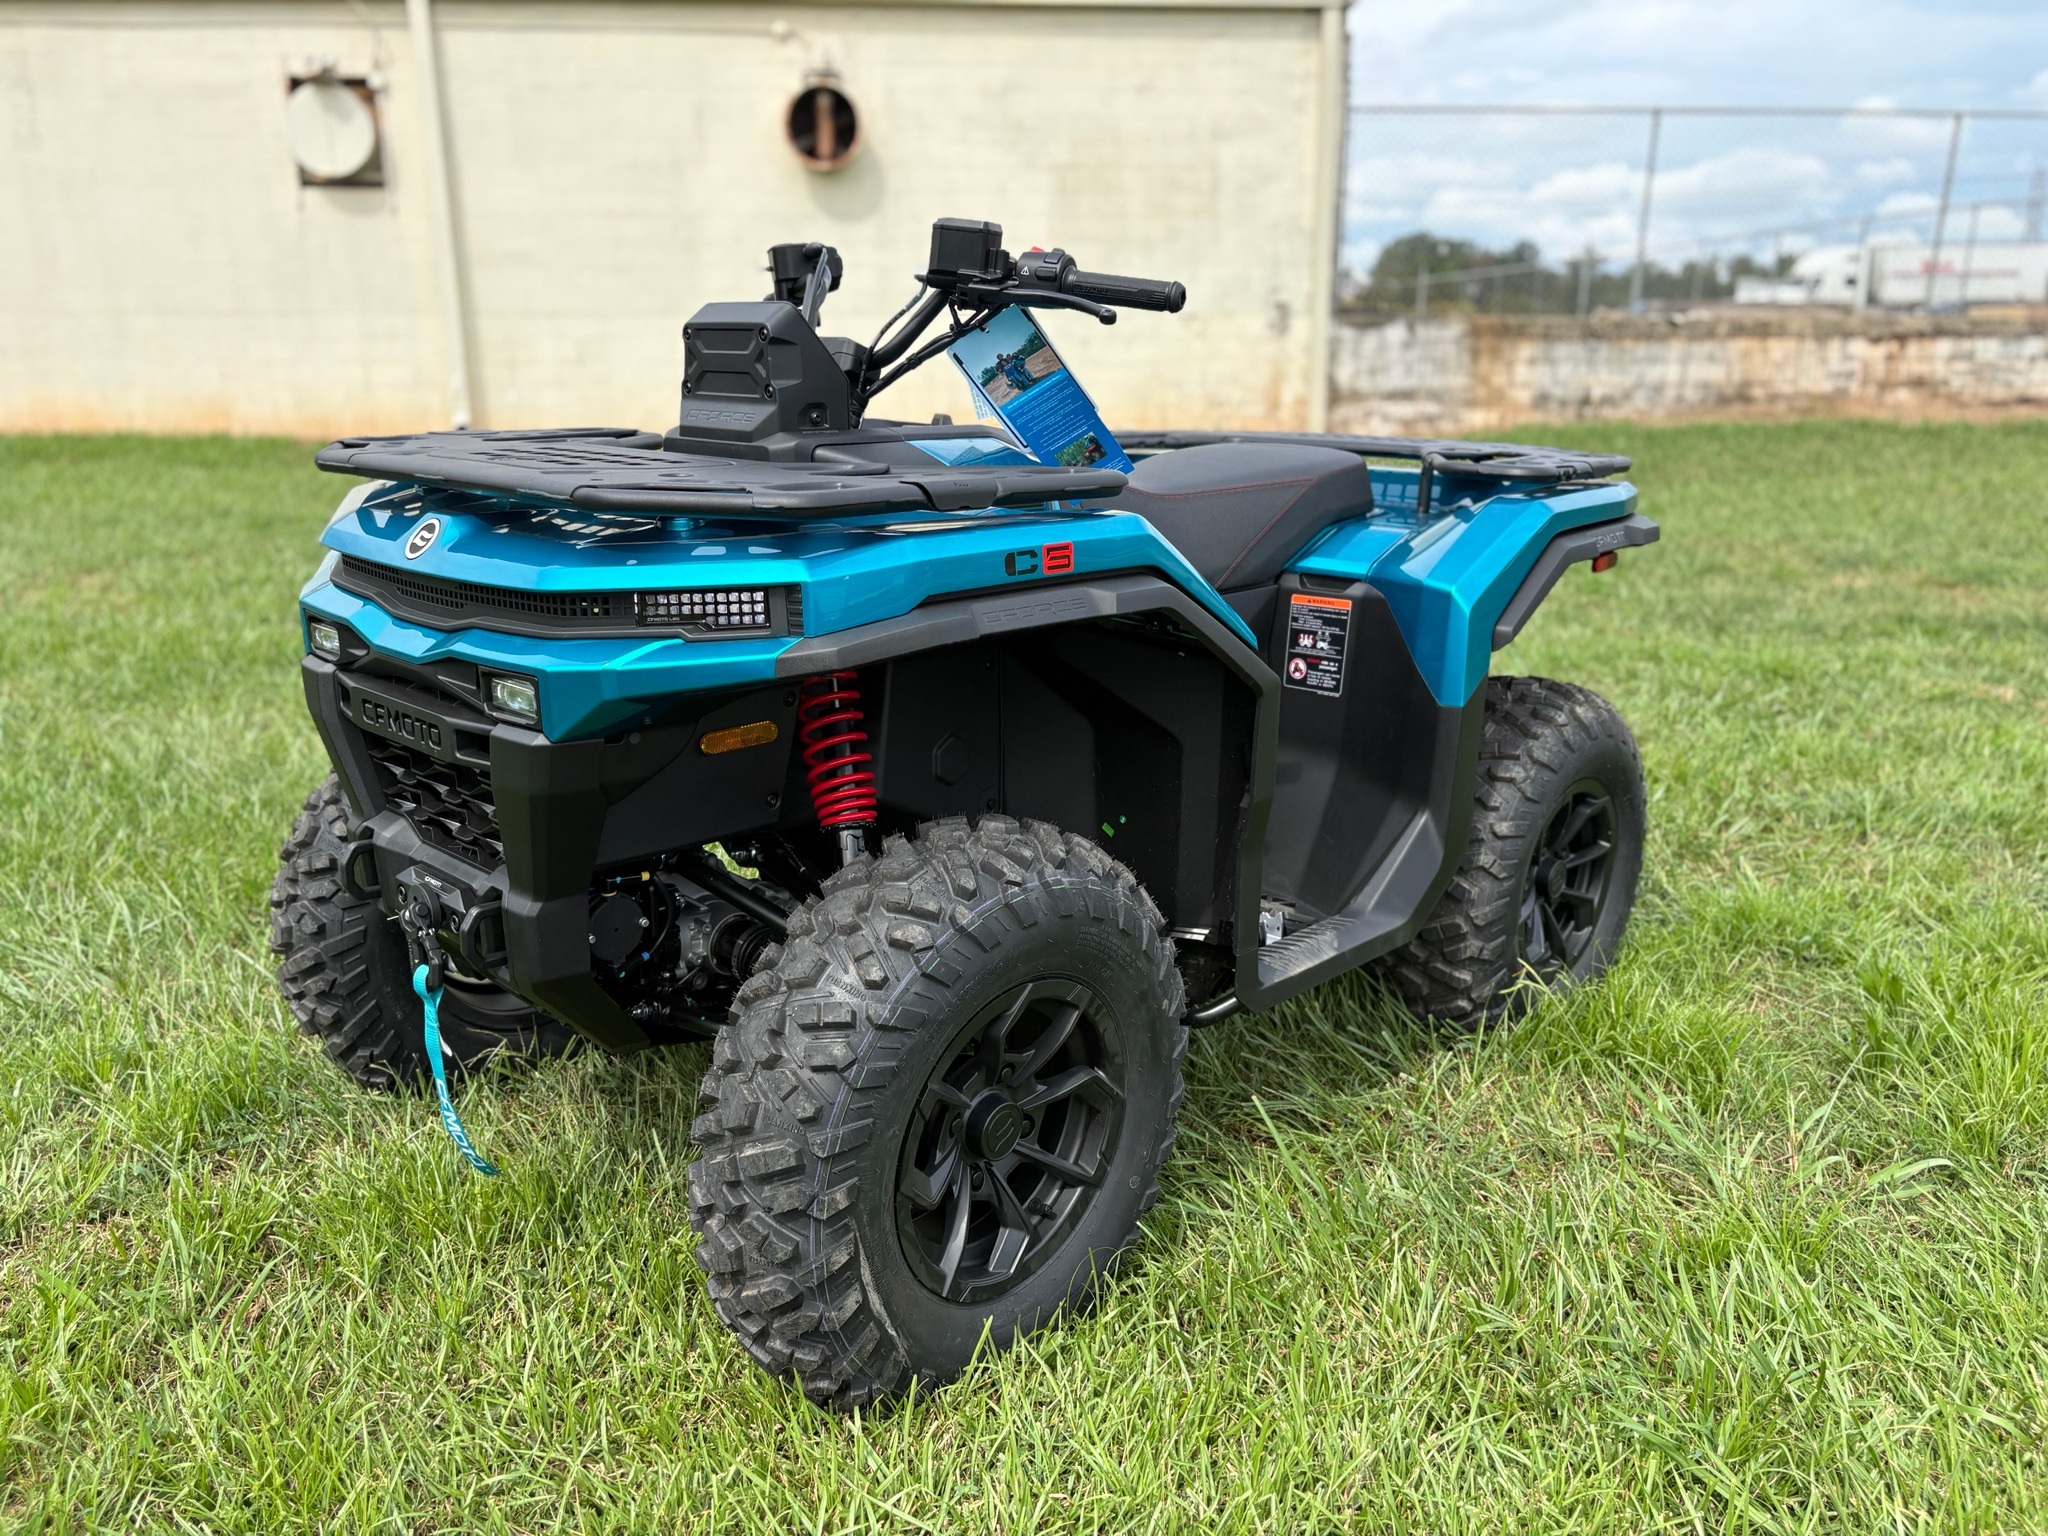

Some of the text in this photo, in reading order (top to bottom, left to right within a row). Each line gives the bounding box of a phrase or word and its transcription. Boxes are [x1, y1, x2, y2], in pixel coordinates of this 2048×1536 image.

[686, 408, 757, 425] CFORCE
[1004, 543, 1074, 577] C5
[982, 596, 1088, 624] CFORCE
[361, 697, 443, 751] CFMOTO
[436, 1078, 487, 1167] CFMOTO
